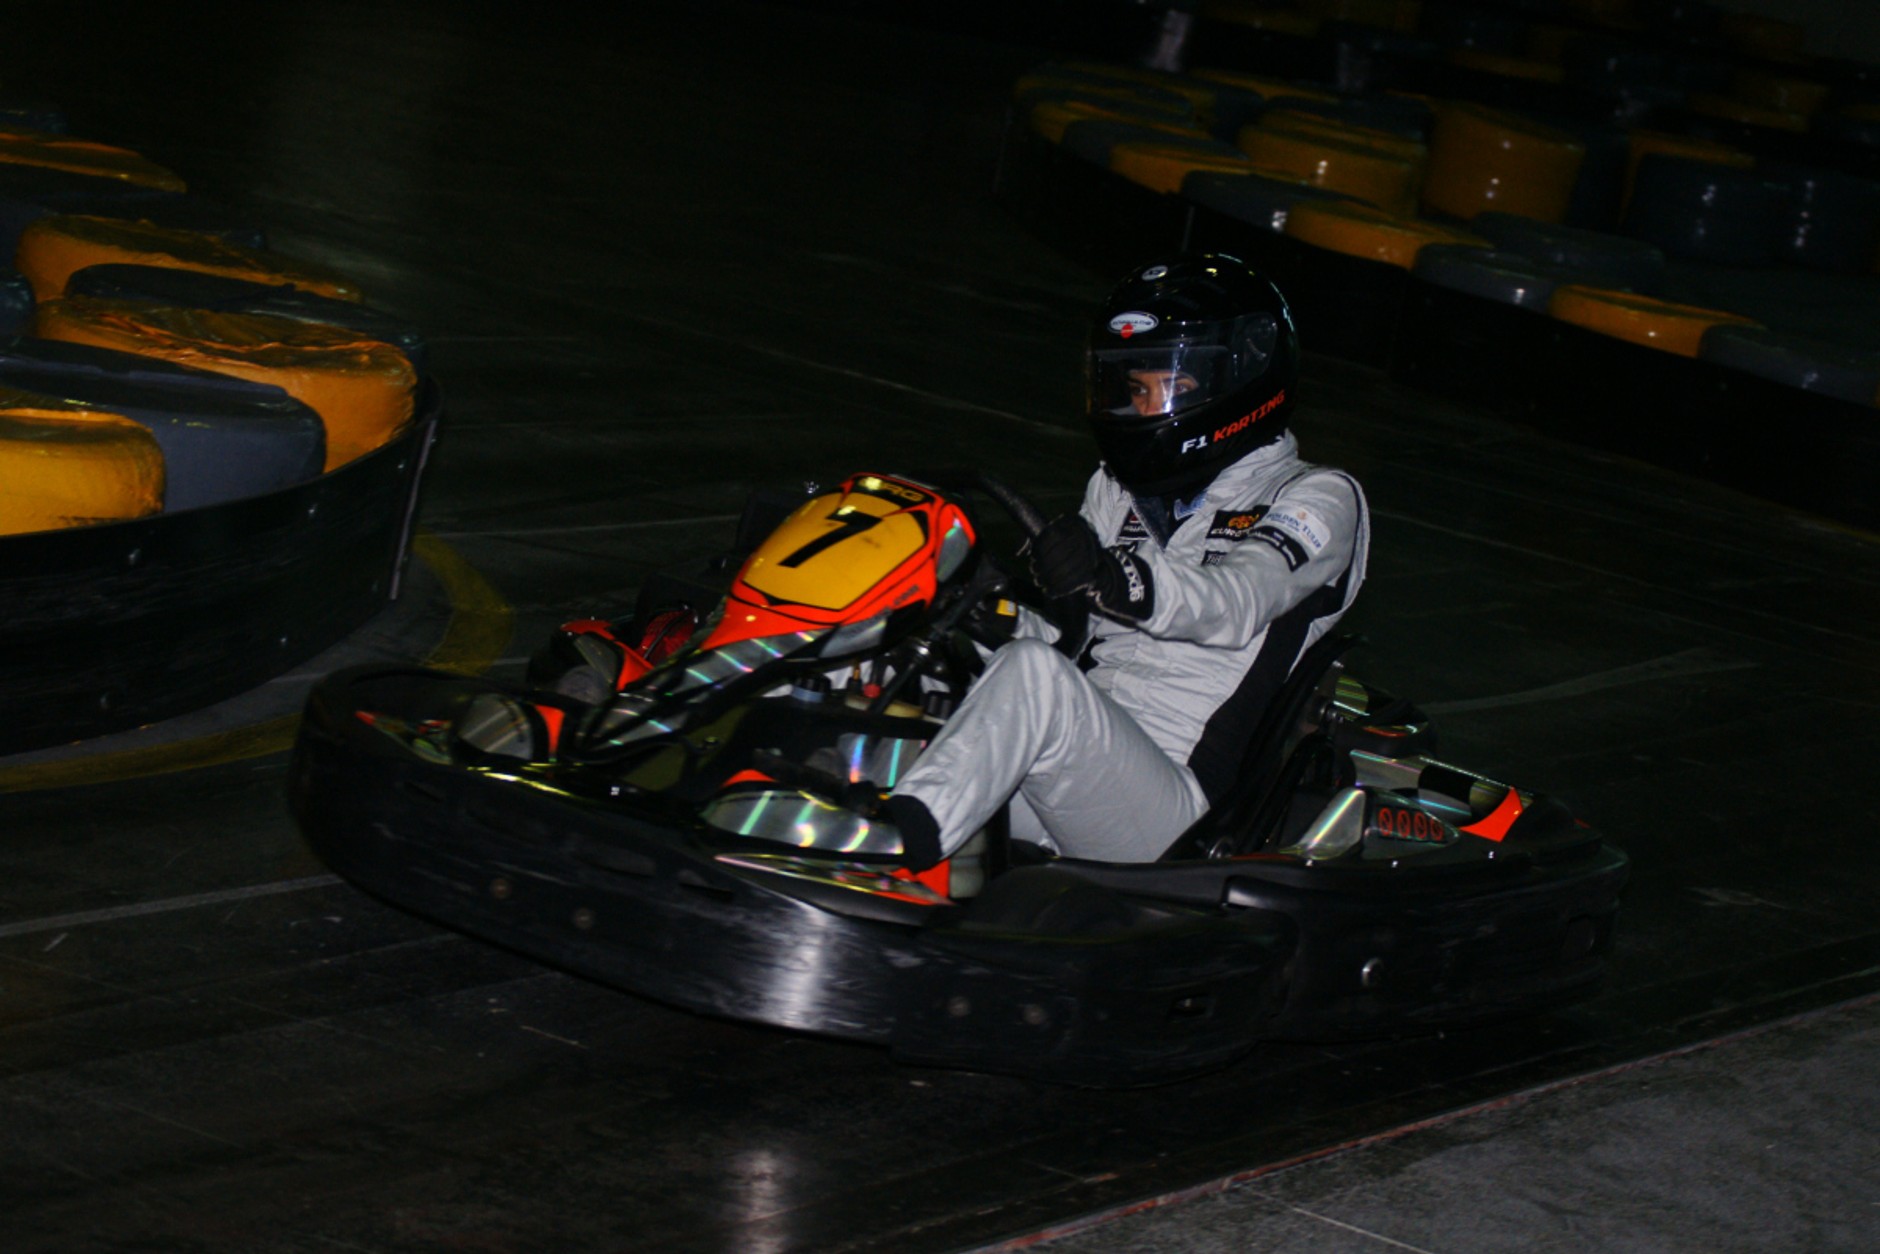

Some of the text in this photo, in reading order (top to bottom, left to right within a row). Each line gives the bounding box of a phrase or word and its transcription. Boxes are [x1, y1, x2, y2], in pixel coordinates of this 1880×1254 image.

[1181, 388, 1286, 455] F1 KARTING
[777, 504, 882, 568] 7
